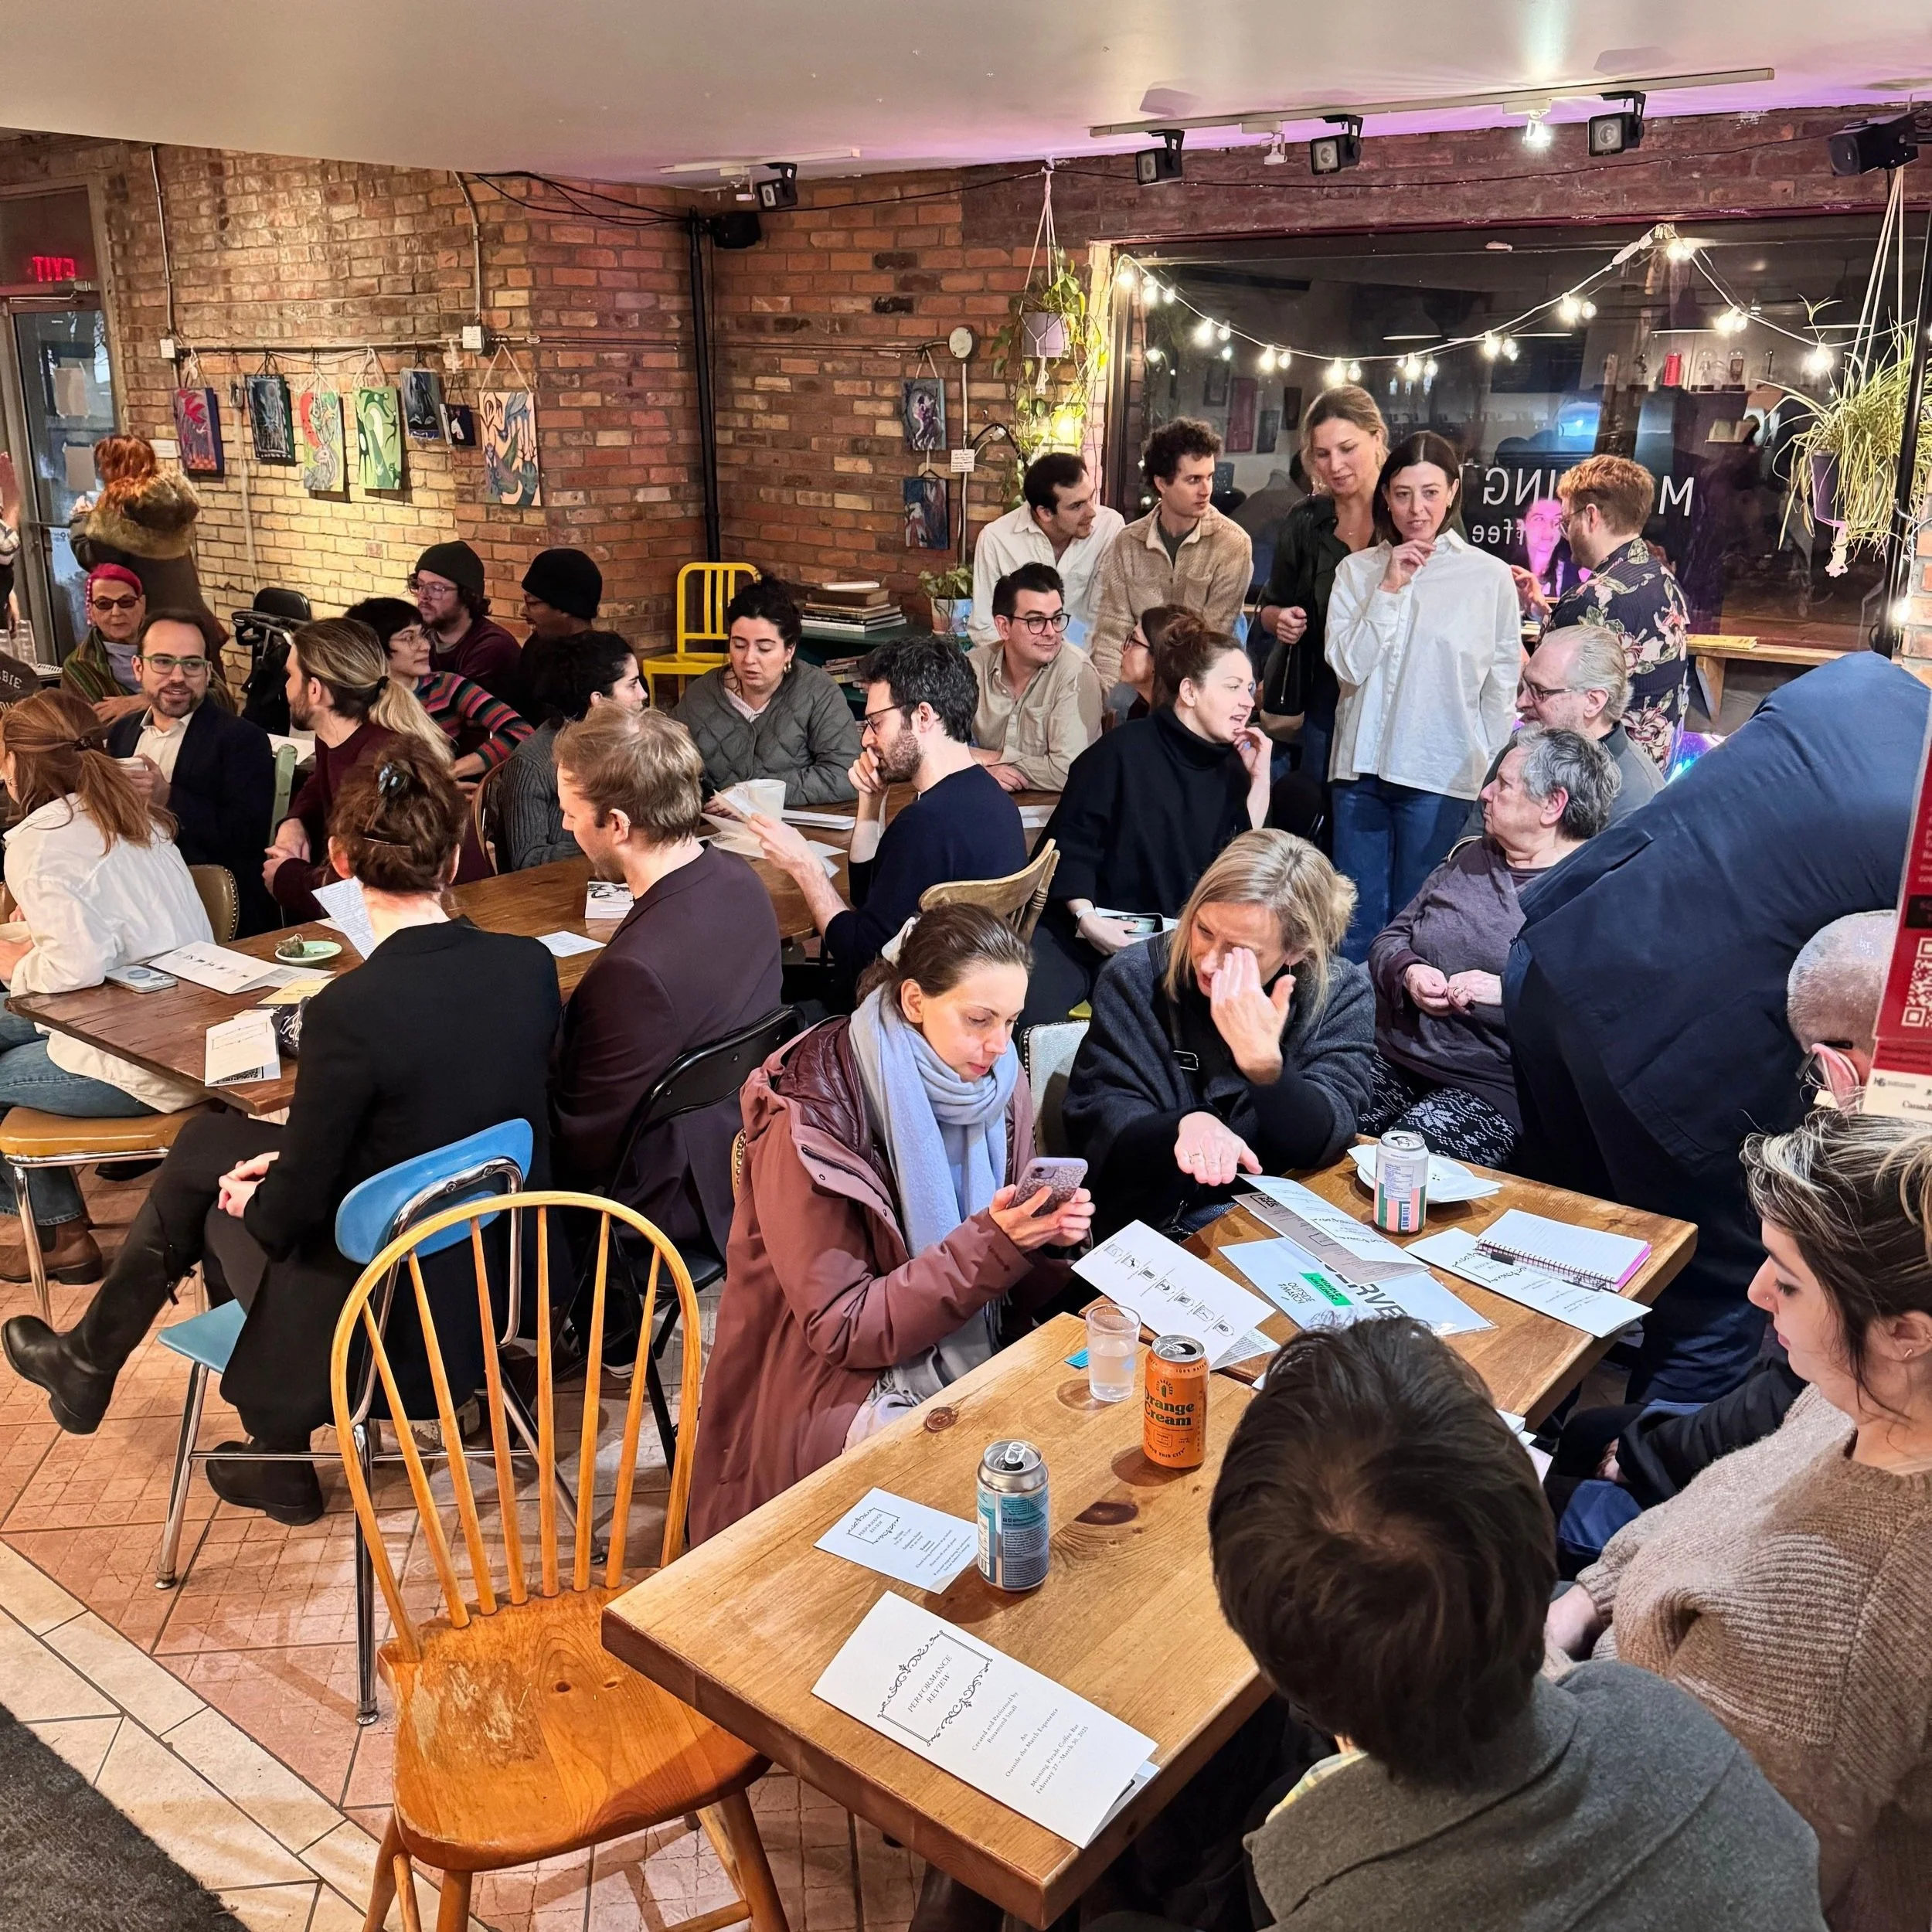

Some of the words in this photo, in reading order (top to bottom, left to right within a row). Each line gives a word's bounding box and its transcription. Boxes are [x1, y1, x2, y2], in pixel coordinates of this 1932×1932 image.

[1145, 1400, 1192, 1426] Cream
[907, 1654, 952, 1713] PERFORMANCE
[927, 1672, 950, 1703] REVIEW
[972, 1730, 988, 1751] Created
[992, 1697, 1013, 1721] Performed
[1005, 1705, 1018, 1718] Small
[1005, 1757, 1021, 1777] Outside
[1026, 1732, 1039, 1747] March
[1038, 1708, 1059, 1733] Experience
[1020, 1733, 1028, 1741] An
[1031, 1762, 1049, 1787] Morning
[1046, 1748, 1060, 1764] Parade
[1058, 1735, 1070, 1748] Coffee
[1070, 1724, 1079, 1733] Bar
[1036, 1771, 1055, 1794] February
[1052, 1763, 1059, 1771] 27
[1060, 1745, 1073, 1760] March
